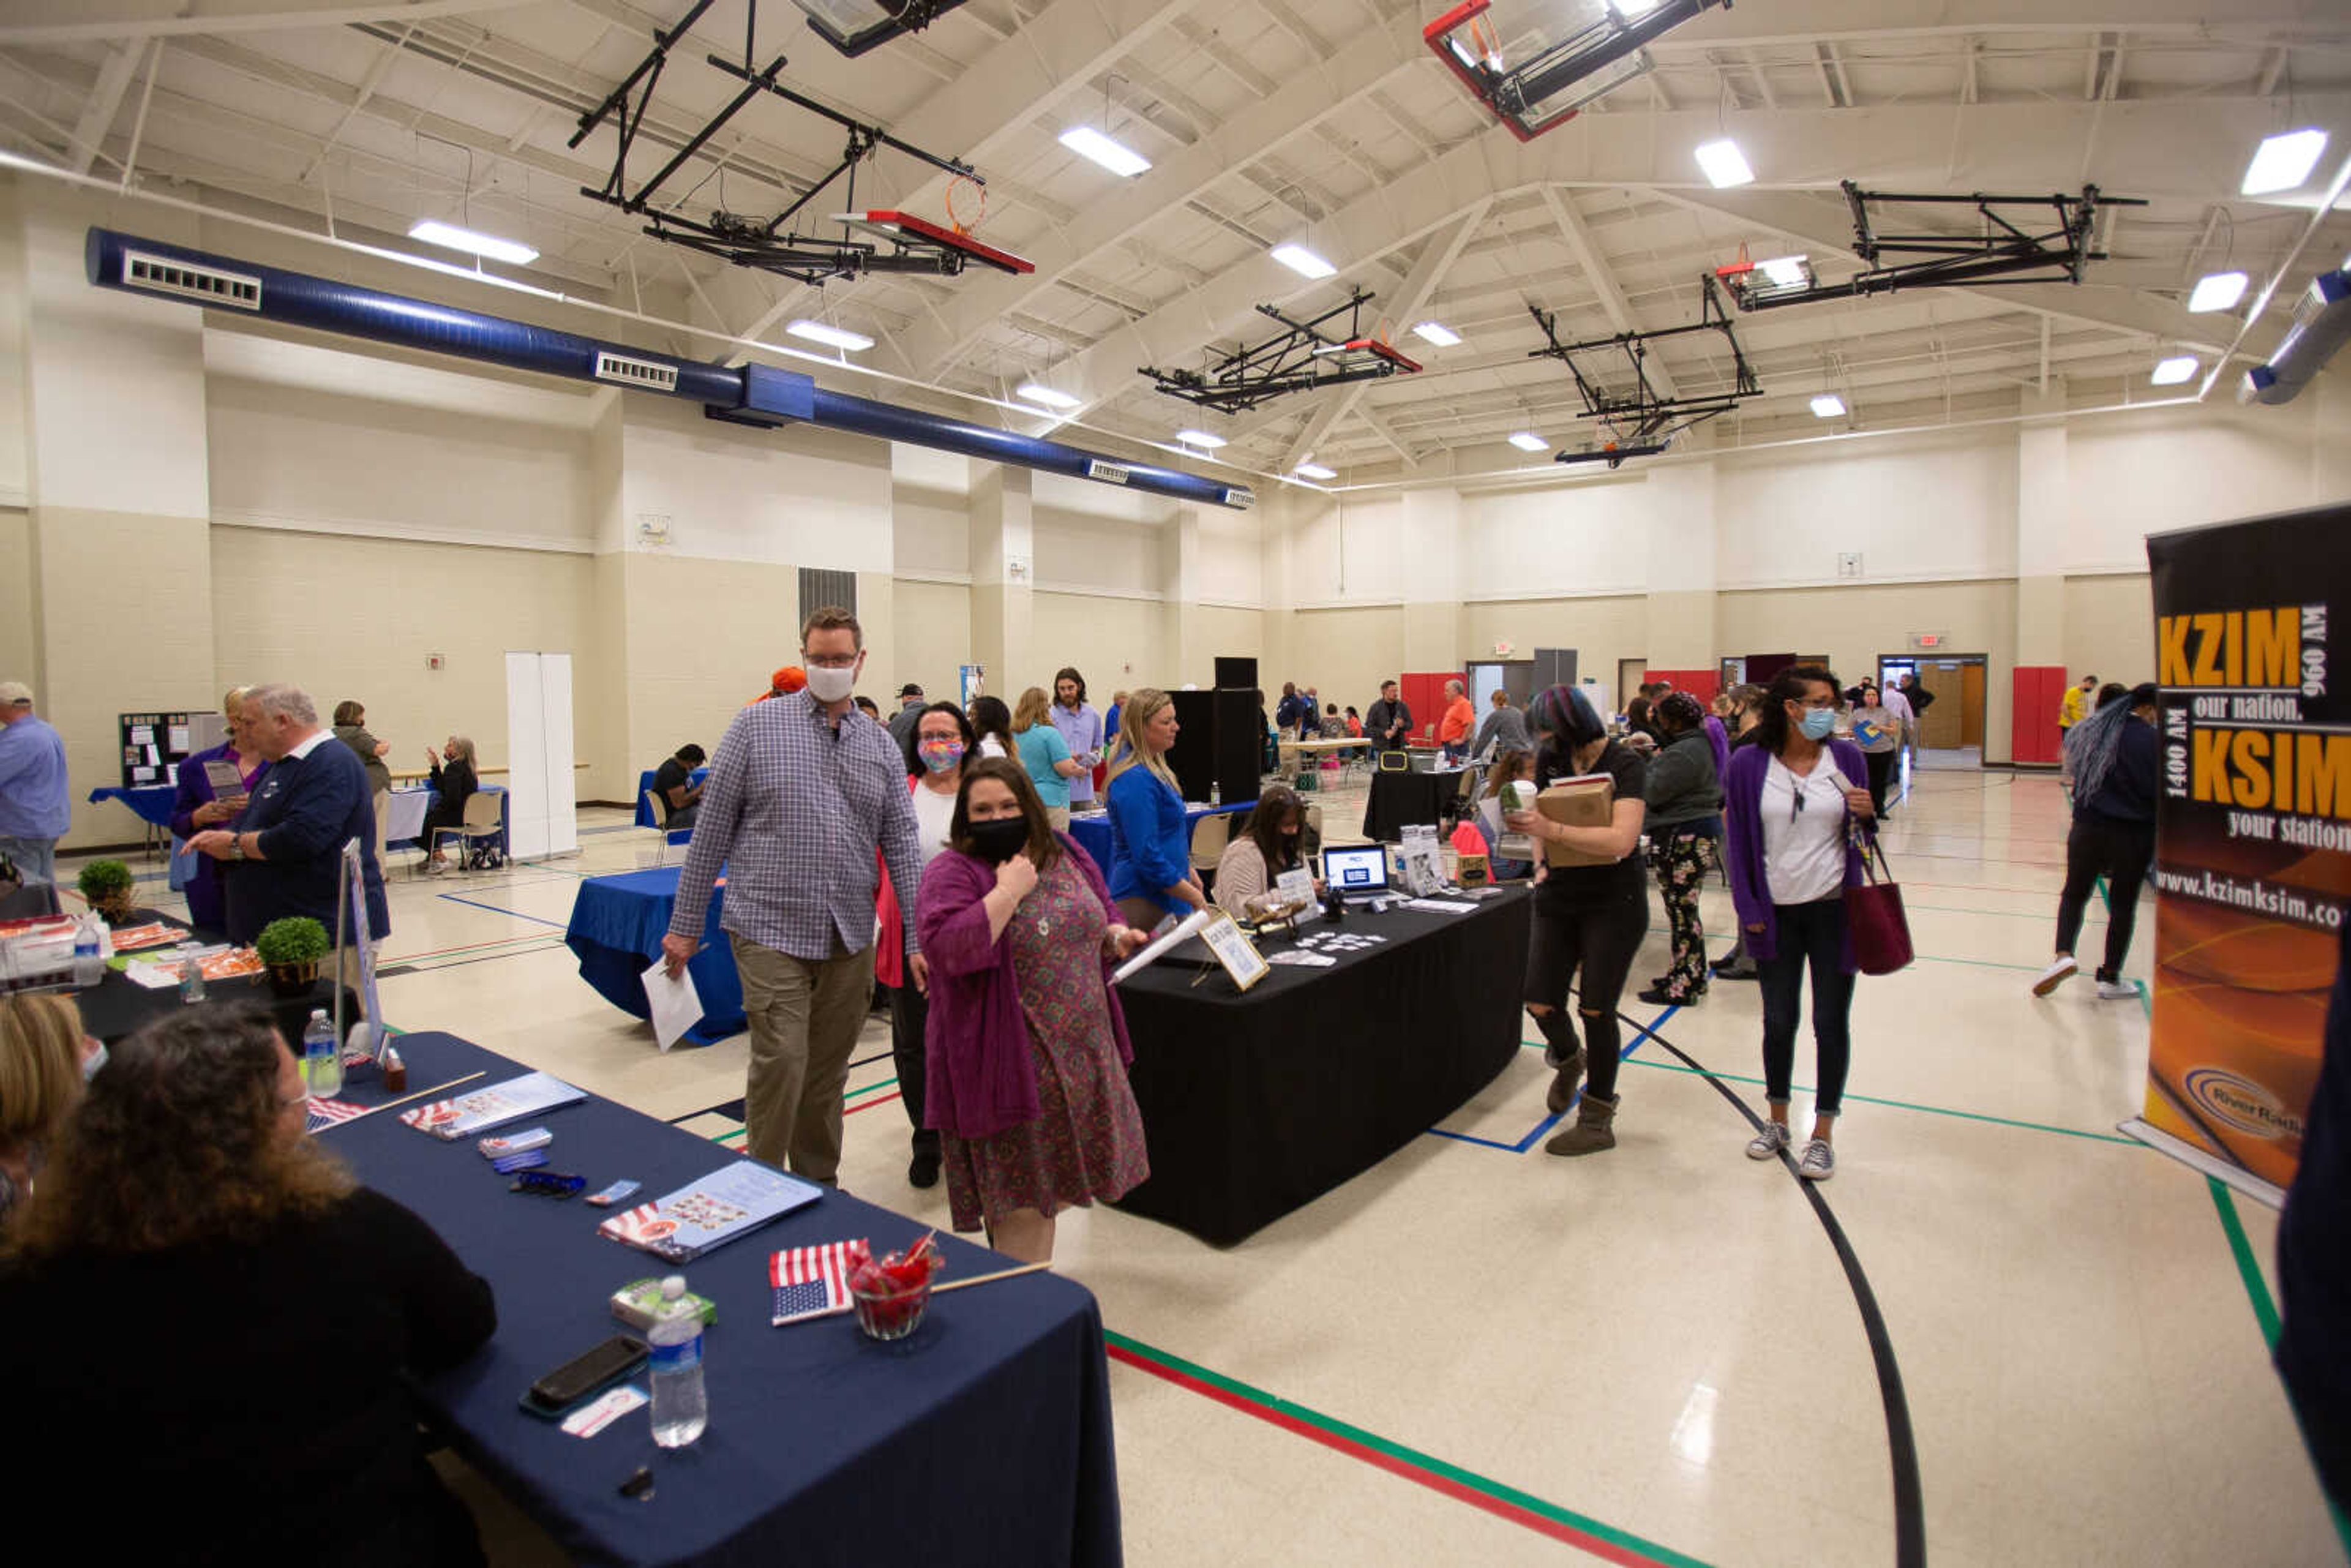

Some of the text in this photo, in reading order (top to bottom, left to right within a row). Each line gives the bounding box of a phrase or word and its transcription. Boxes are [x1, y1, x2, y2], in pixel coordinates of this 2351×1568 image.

[2159, 607, 2300, 686] KZIM
[2301, 606, 2326, 697] 960 AM
[2194, 694, 2303, 721] our nation.
[2167, 708, 2188, 797] 1400 AM
[2193, 729, 2351, 819] KSIM
[2229, 812, 2351, 852] your station
[2156, 870, 2341, 926] www.kzimksim.co
